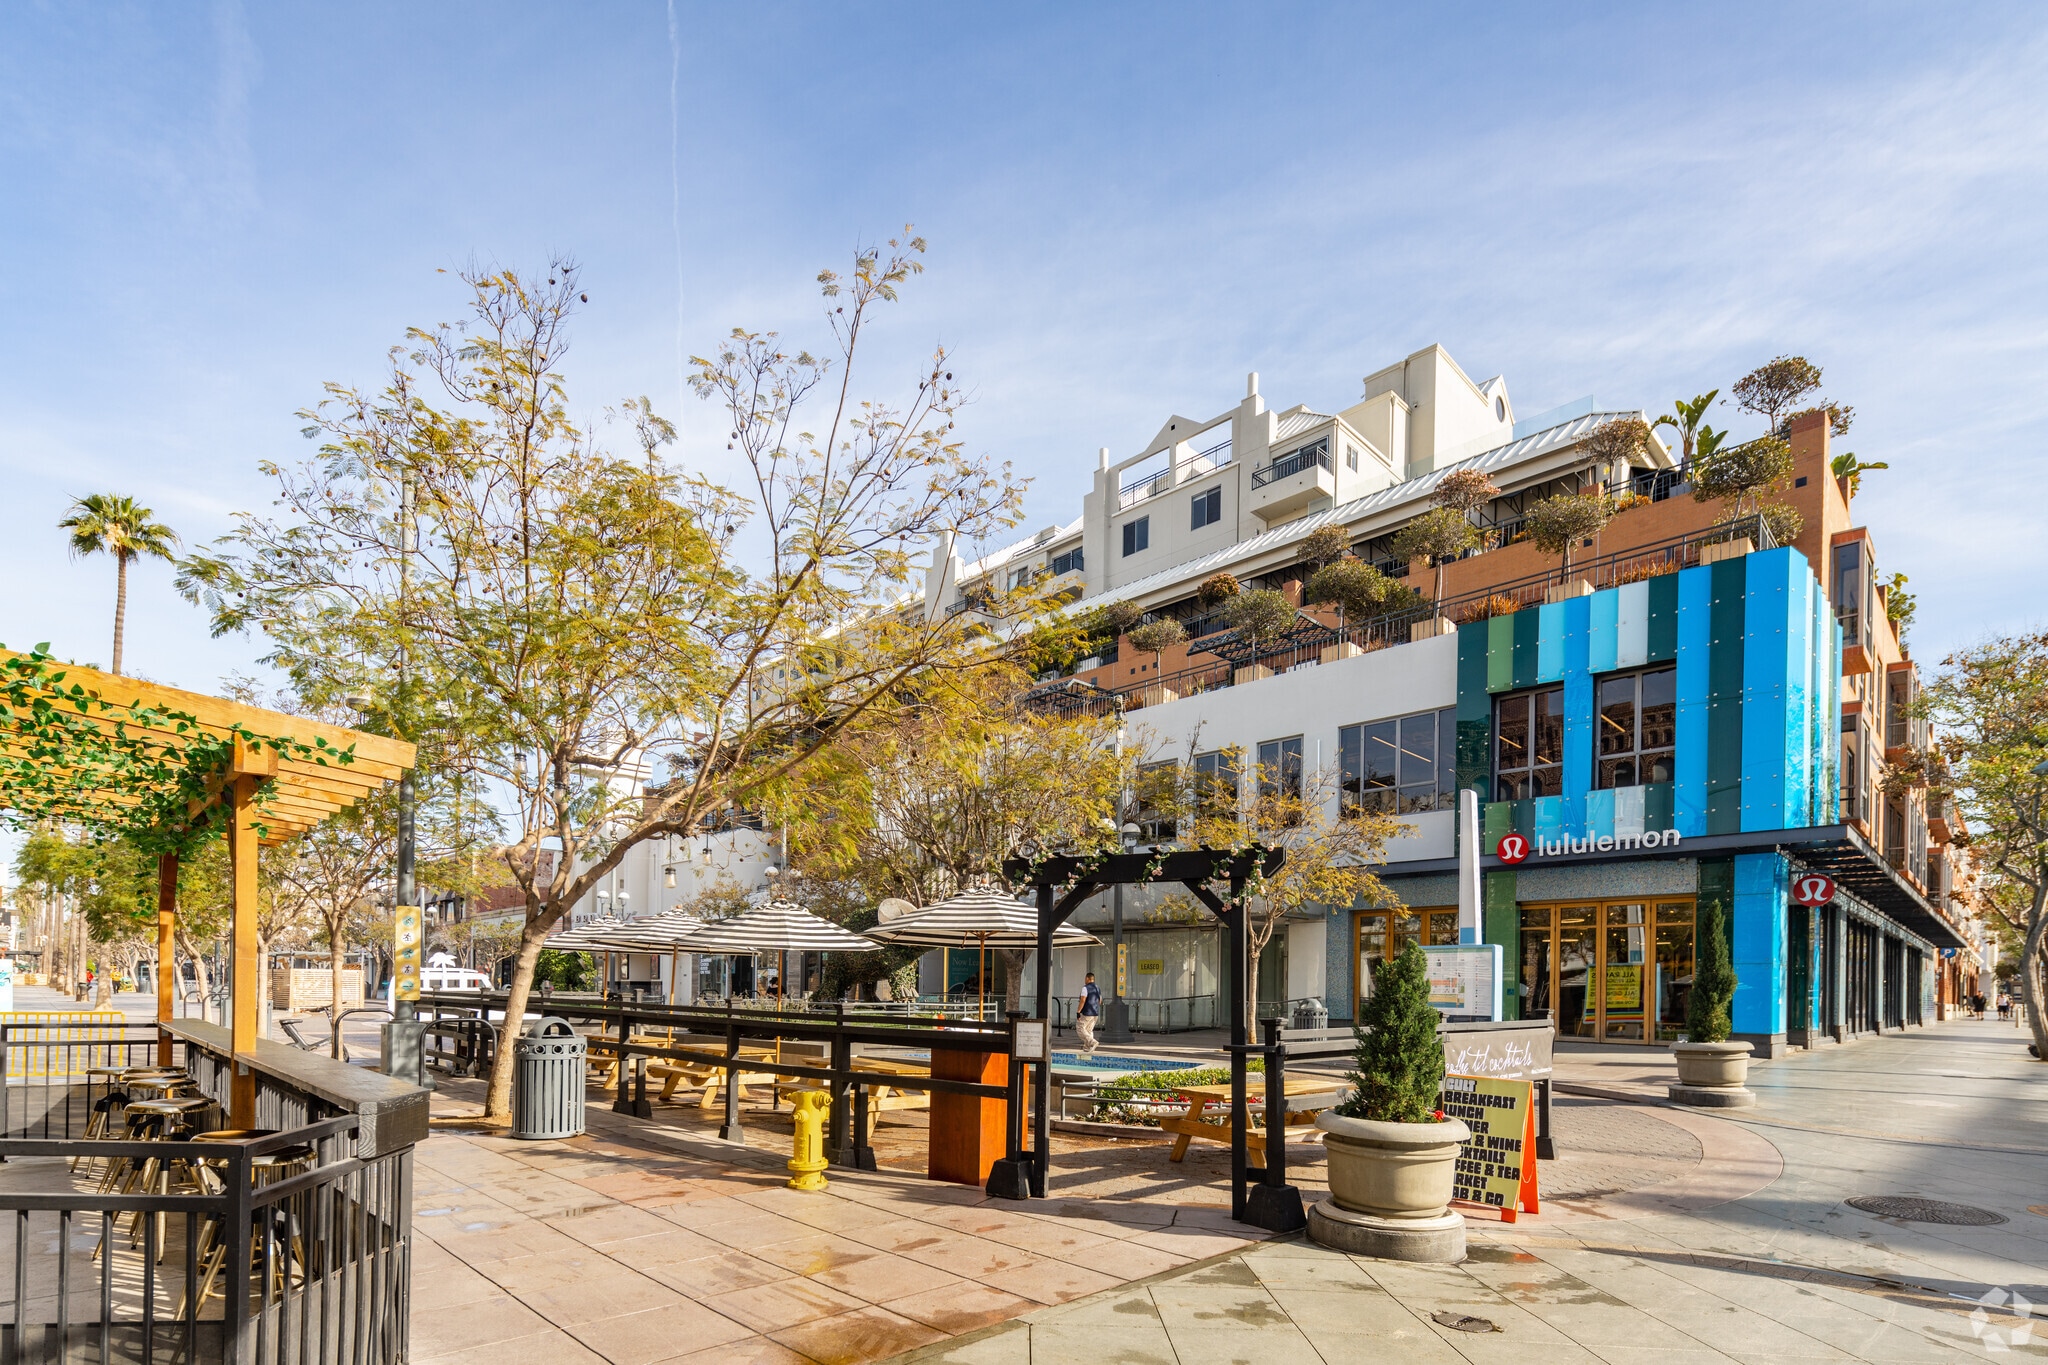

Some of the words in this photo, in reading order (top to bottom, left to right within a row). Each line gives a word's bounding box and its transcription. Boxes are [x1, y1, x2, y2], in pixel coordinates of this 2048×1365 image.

[1538, 829, 1681, 857] lululemon
[1489, 1041, 1532, 1072] cocktails
[1445, 1078, 1477, 1092] CULT
[1444, 1091, 1516, 1109] BREAKFAST
[1444, 1103, 1484, 1119] LUNCH
[1475, 1134, 1485, 1147] &
[1487, 1136, 1521, 1152] WINE
[1455, 1158, 1482, 1174] FFEE
[1484, 1163, 1495, 1177] &
[1497, 1165, 1520, 1180] TEA
[1454, 1172, 1488, 1189] RKET
[1471, 1189, 1482, 1202] &
[1485, 1191, 1504, 1206] GO
